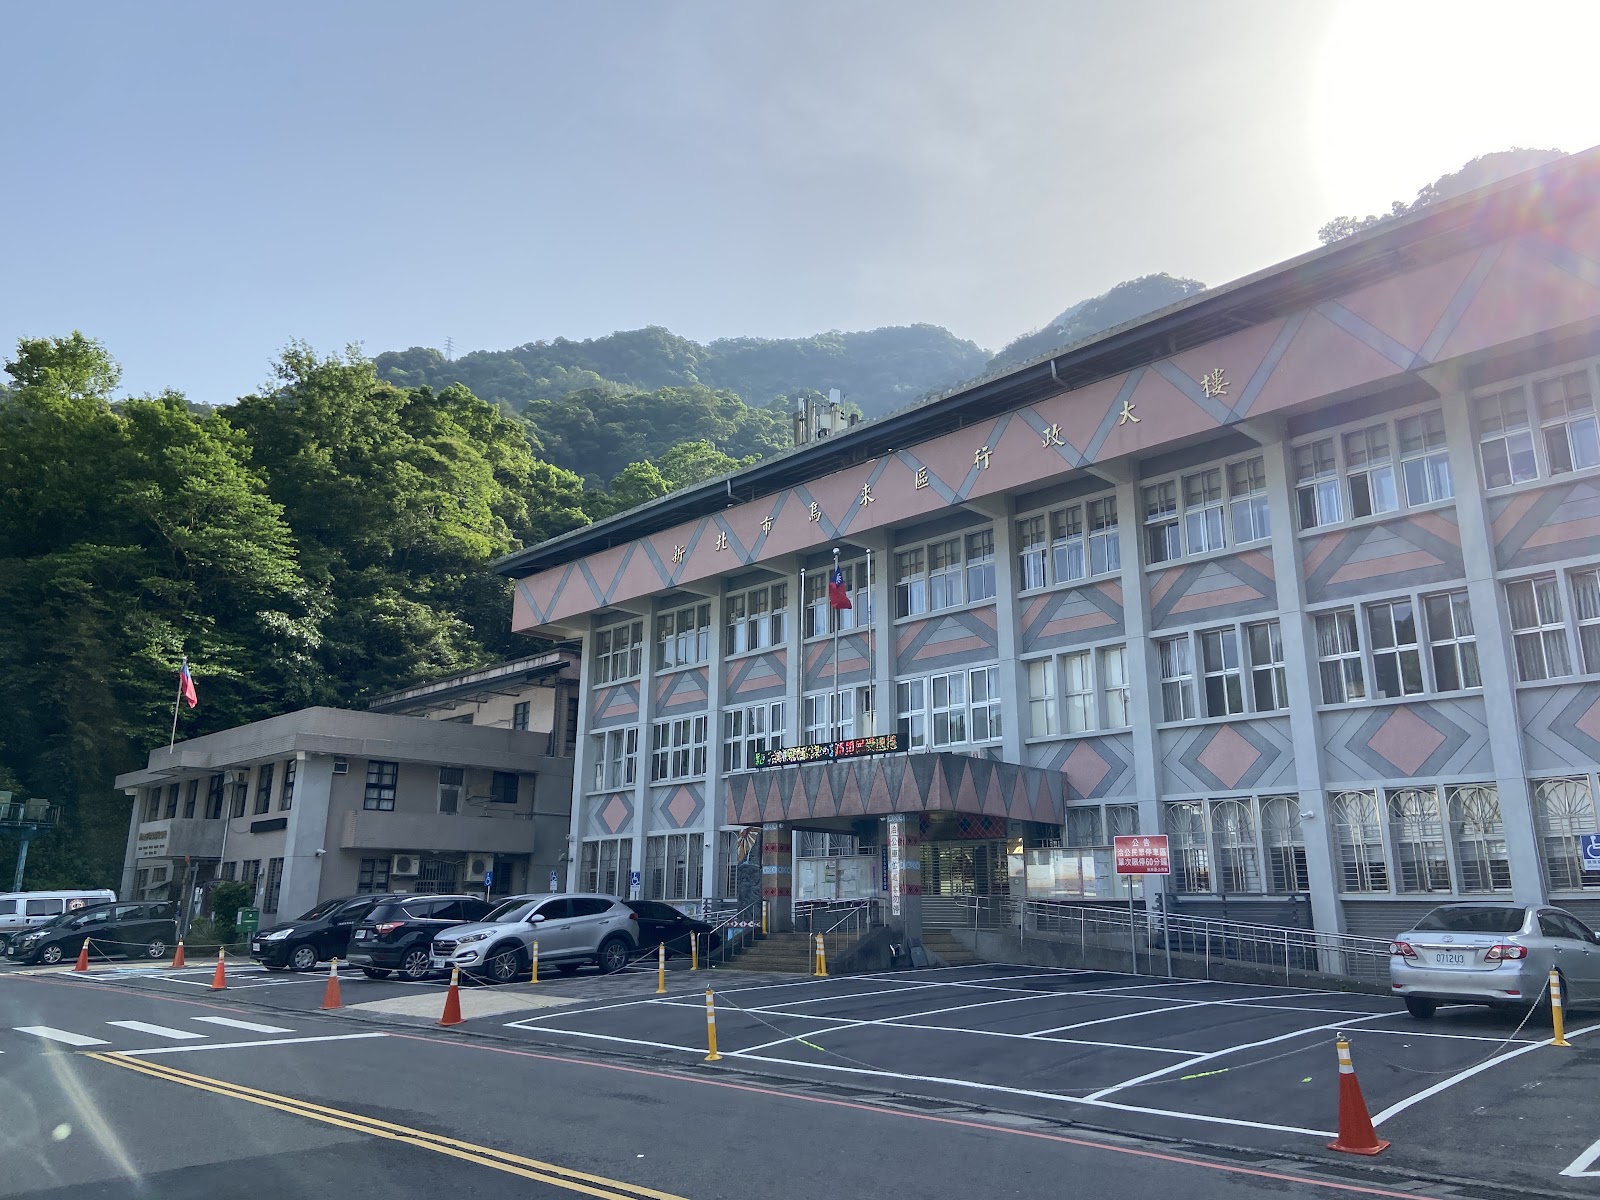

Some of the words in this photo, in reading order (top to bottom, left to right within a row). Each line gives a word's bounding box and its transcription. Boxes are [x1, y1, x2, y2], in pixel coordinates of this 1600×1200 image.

[671, 367, 1230, 565] 新北市烏來區行政大樓
[1132, 838, 1150, 846] 公告
